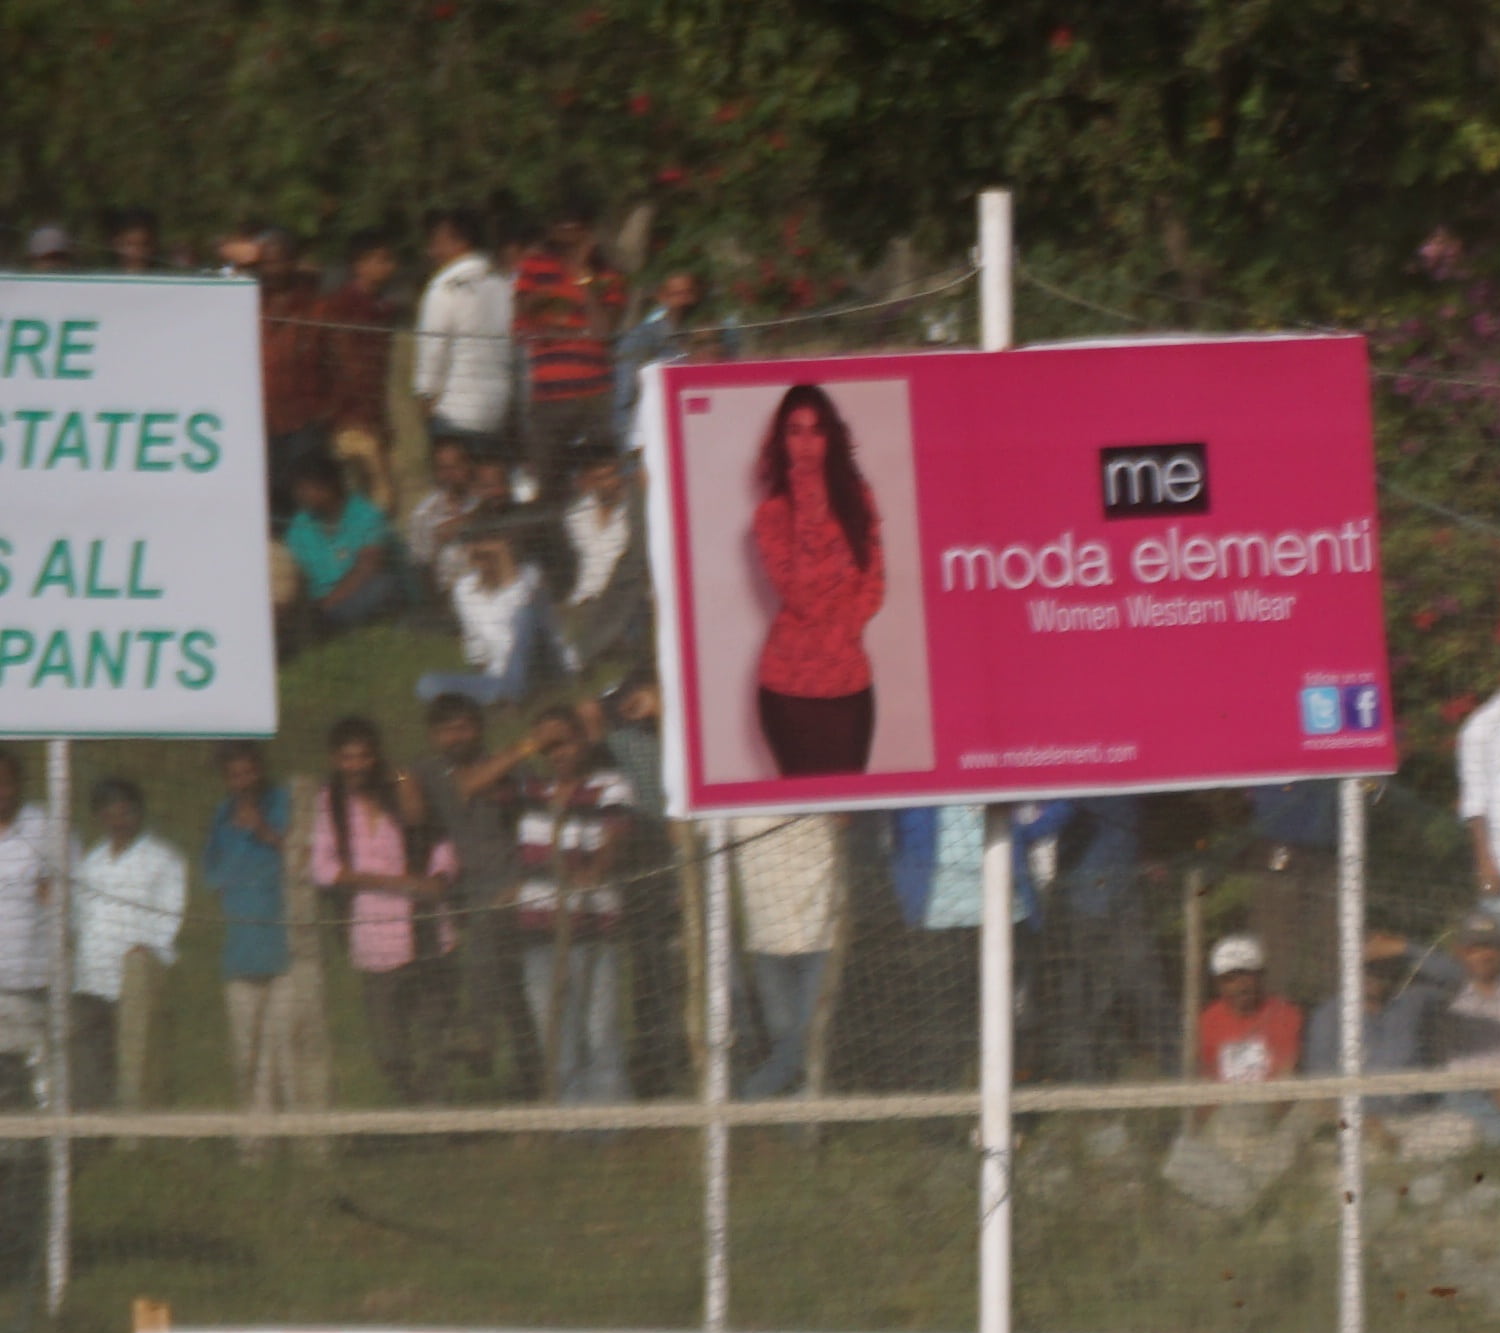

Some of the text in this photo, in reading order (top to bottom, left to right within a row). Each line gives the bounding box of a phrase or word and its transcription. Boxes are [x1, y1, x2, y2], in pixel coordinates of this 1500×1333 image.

[0, 319, 100, 379] RE
[0, 410, 224, 473] TATES
[1105, 453, 1201, 506] me
[30, 539, 163, 600] ALL
[942, 519, 1376, 592] moda elementi
[1028, 588, 1297, 633] Women Western Wear
